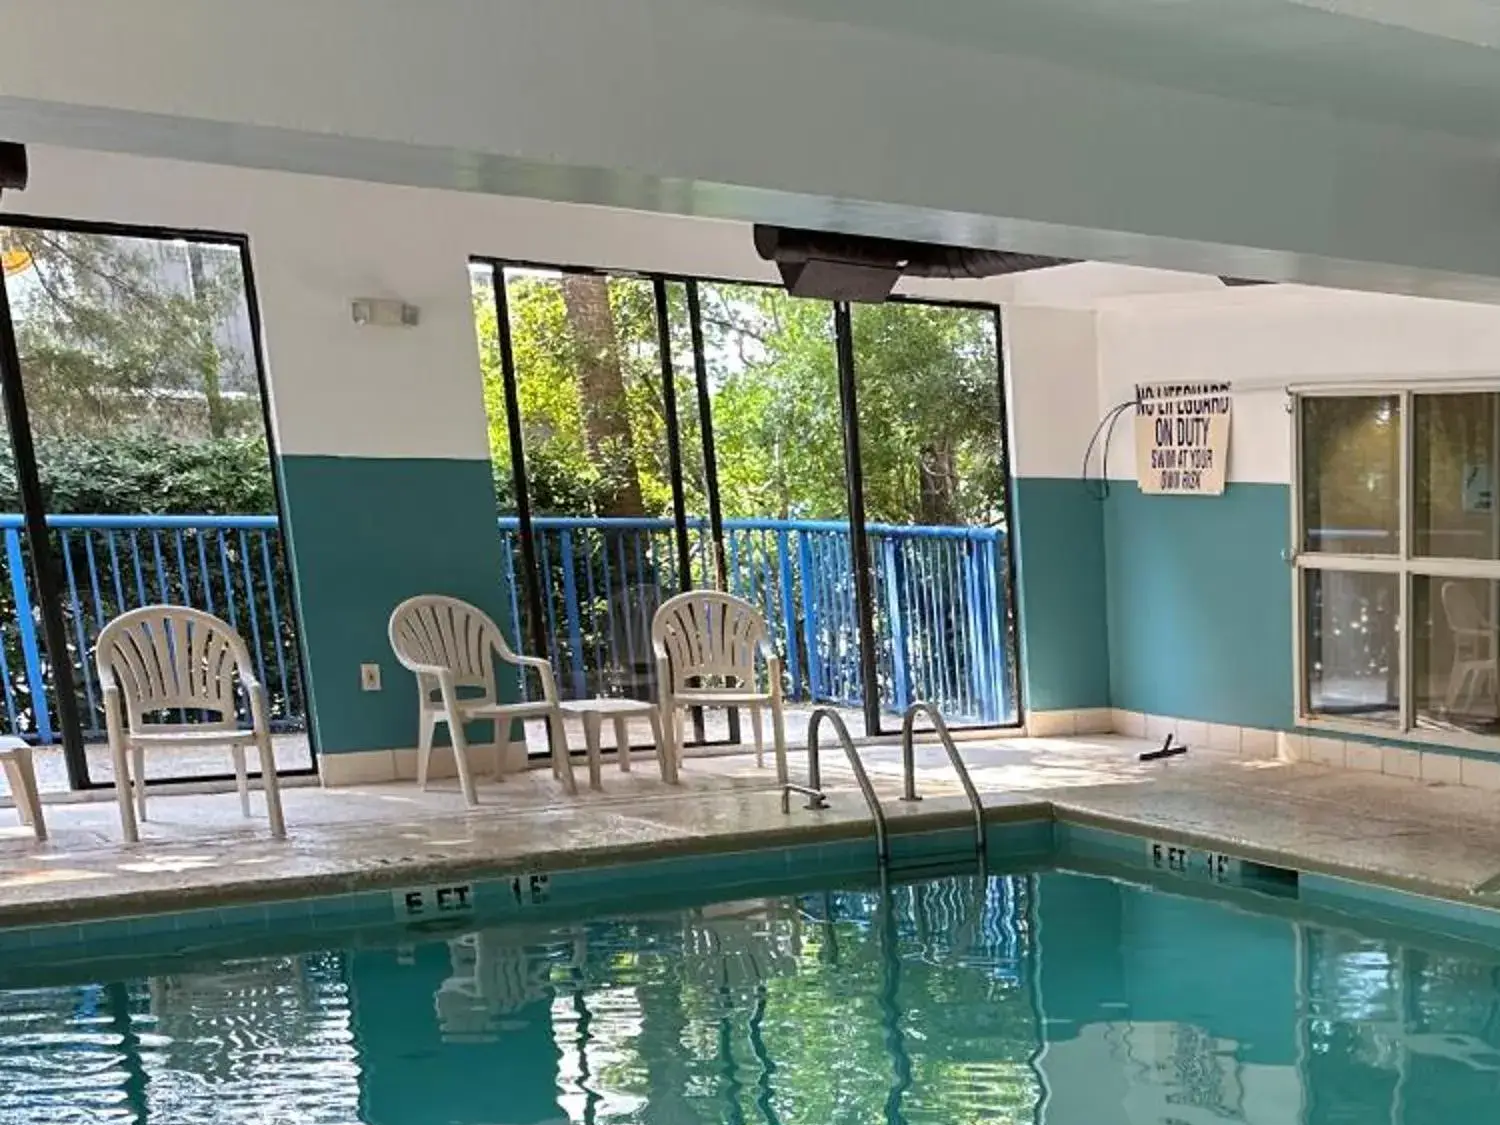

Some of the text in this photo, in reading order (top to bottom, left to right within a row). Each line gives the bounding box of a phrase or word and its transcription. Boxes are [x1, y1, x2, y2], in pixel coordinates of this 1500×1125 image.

[1135, 384, 1154, 415] NO
[1155, 417, 1210, 447] ON DUTY
[1151, 449, 1213, 469] SWIM AT YOUR
[1181, 470, 1202, 490] RISK
